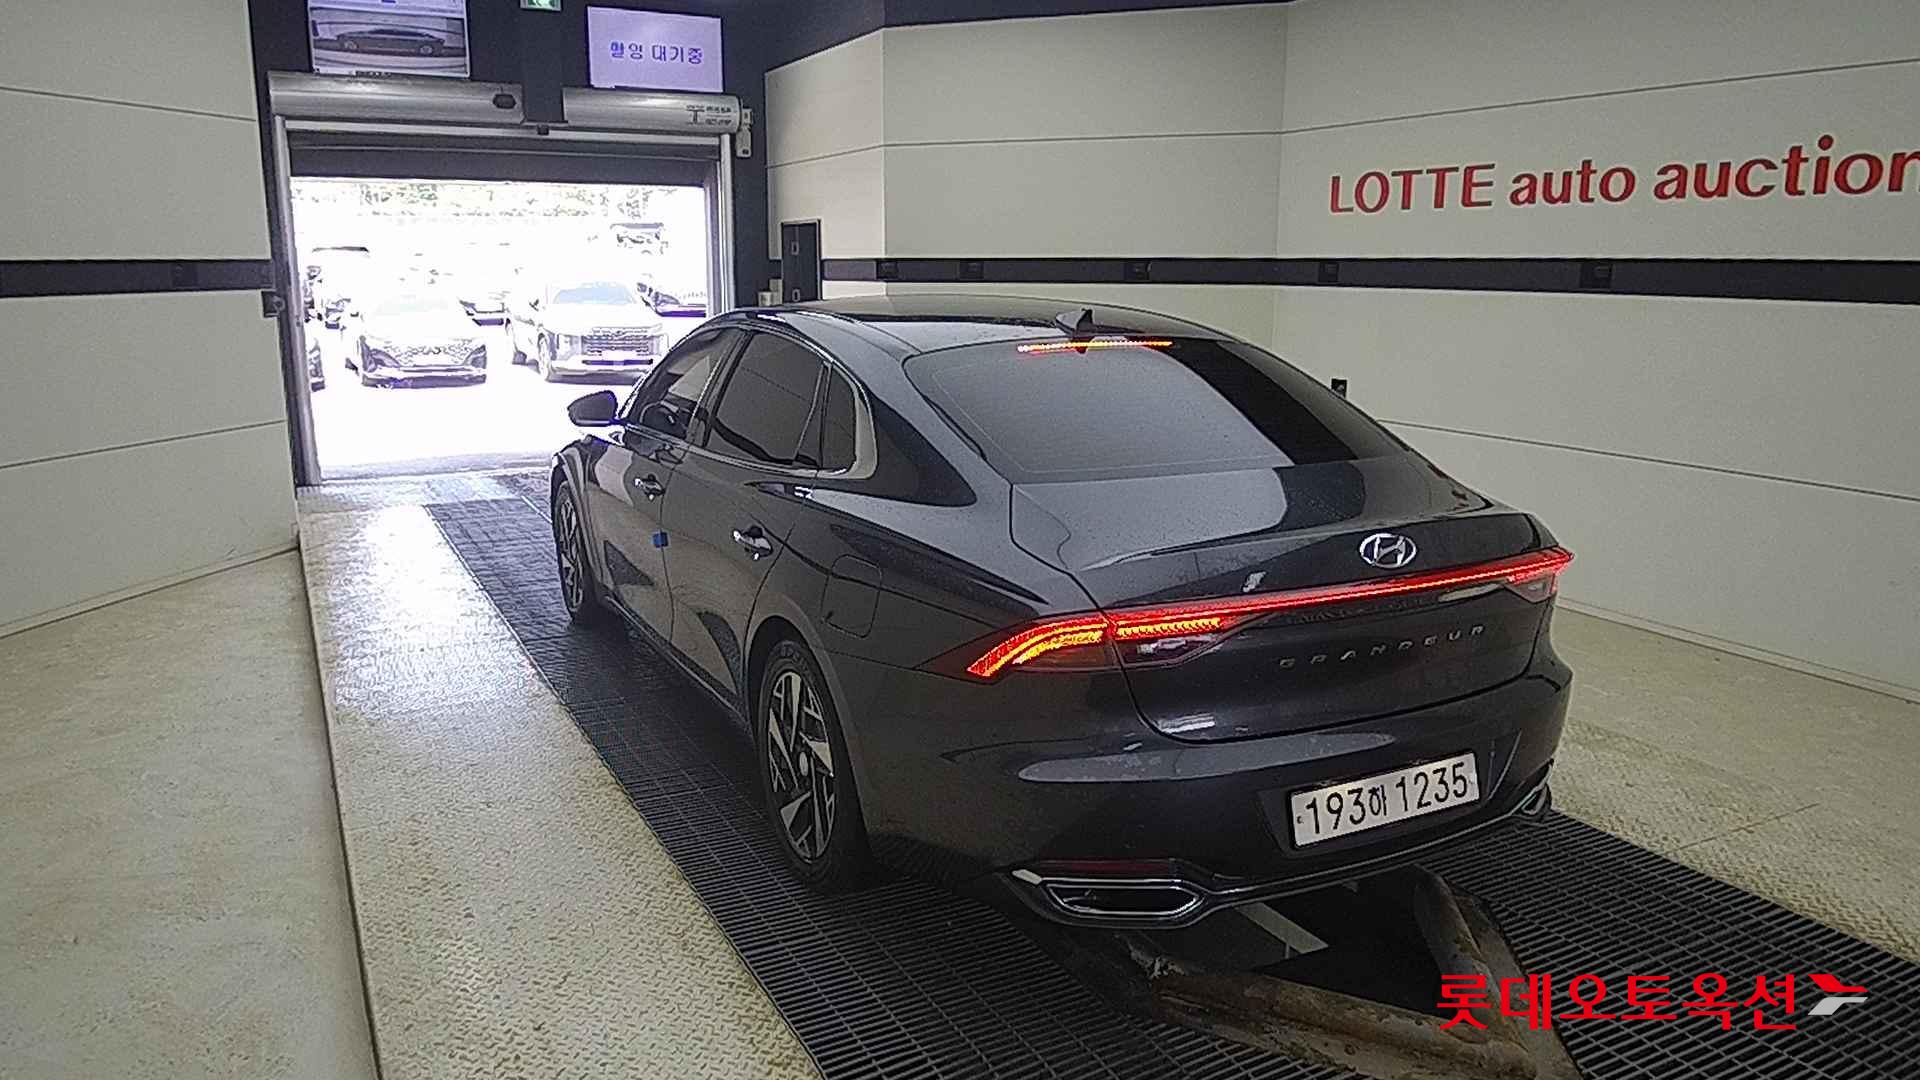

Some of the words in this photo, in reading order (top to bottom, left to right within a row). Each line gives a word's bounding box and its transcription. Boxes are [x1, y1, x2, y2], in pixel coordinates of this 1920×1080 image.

[651, 44, 703, 65] 대기중
[1330, 163, 1496, 214] LOTTE
[1509, 159, 1636, 206] auto
[1305, 784, 1388, 835] 193하
[1395, 761, 1469, 813] 1235
